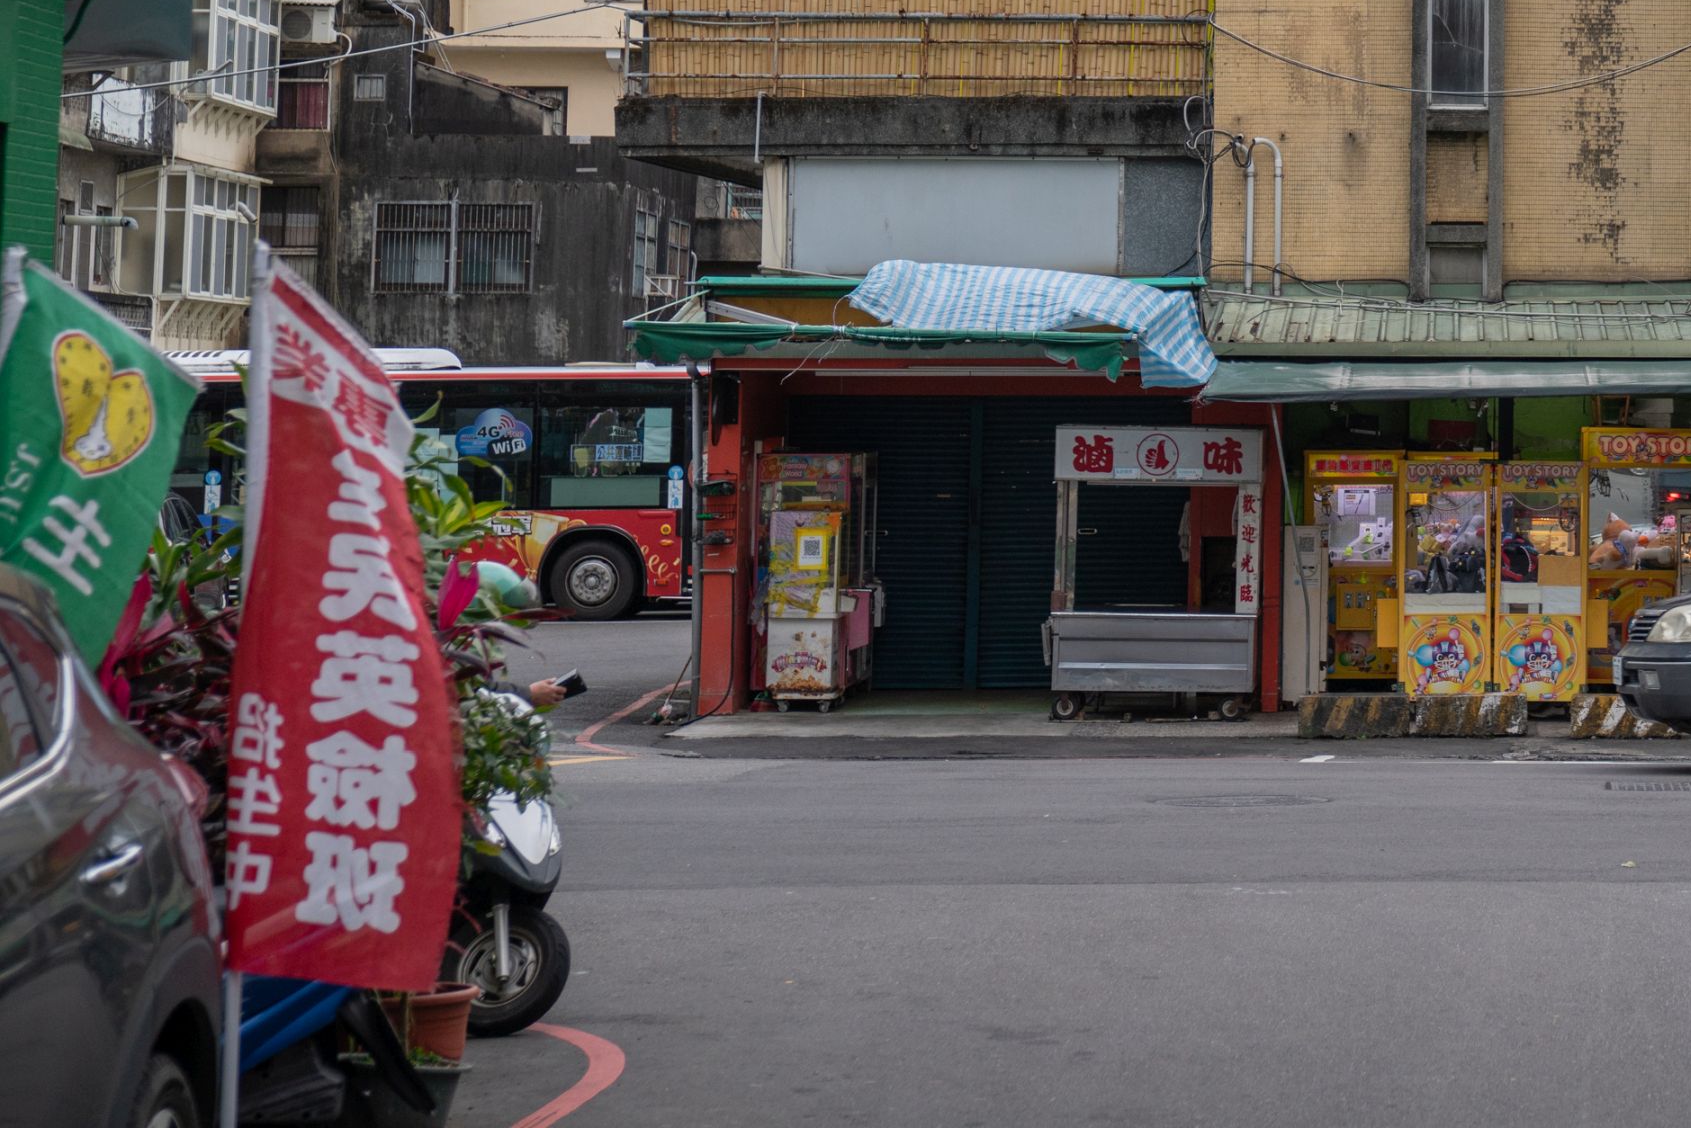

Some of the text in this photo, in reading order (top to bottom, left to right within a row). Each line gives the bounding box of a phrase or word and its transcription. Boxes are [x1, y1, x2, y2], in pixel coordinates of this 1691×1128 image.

[1599, 435, 1642, 455] TOY
[1407, 464, 1437, 478] TOY
[1438, 463, 1485, 478] STORY
[1502, 463, 1580, 478] TOY STORY
[1240, 494, 1257, 603] 歡迎光臨
